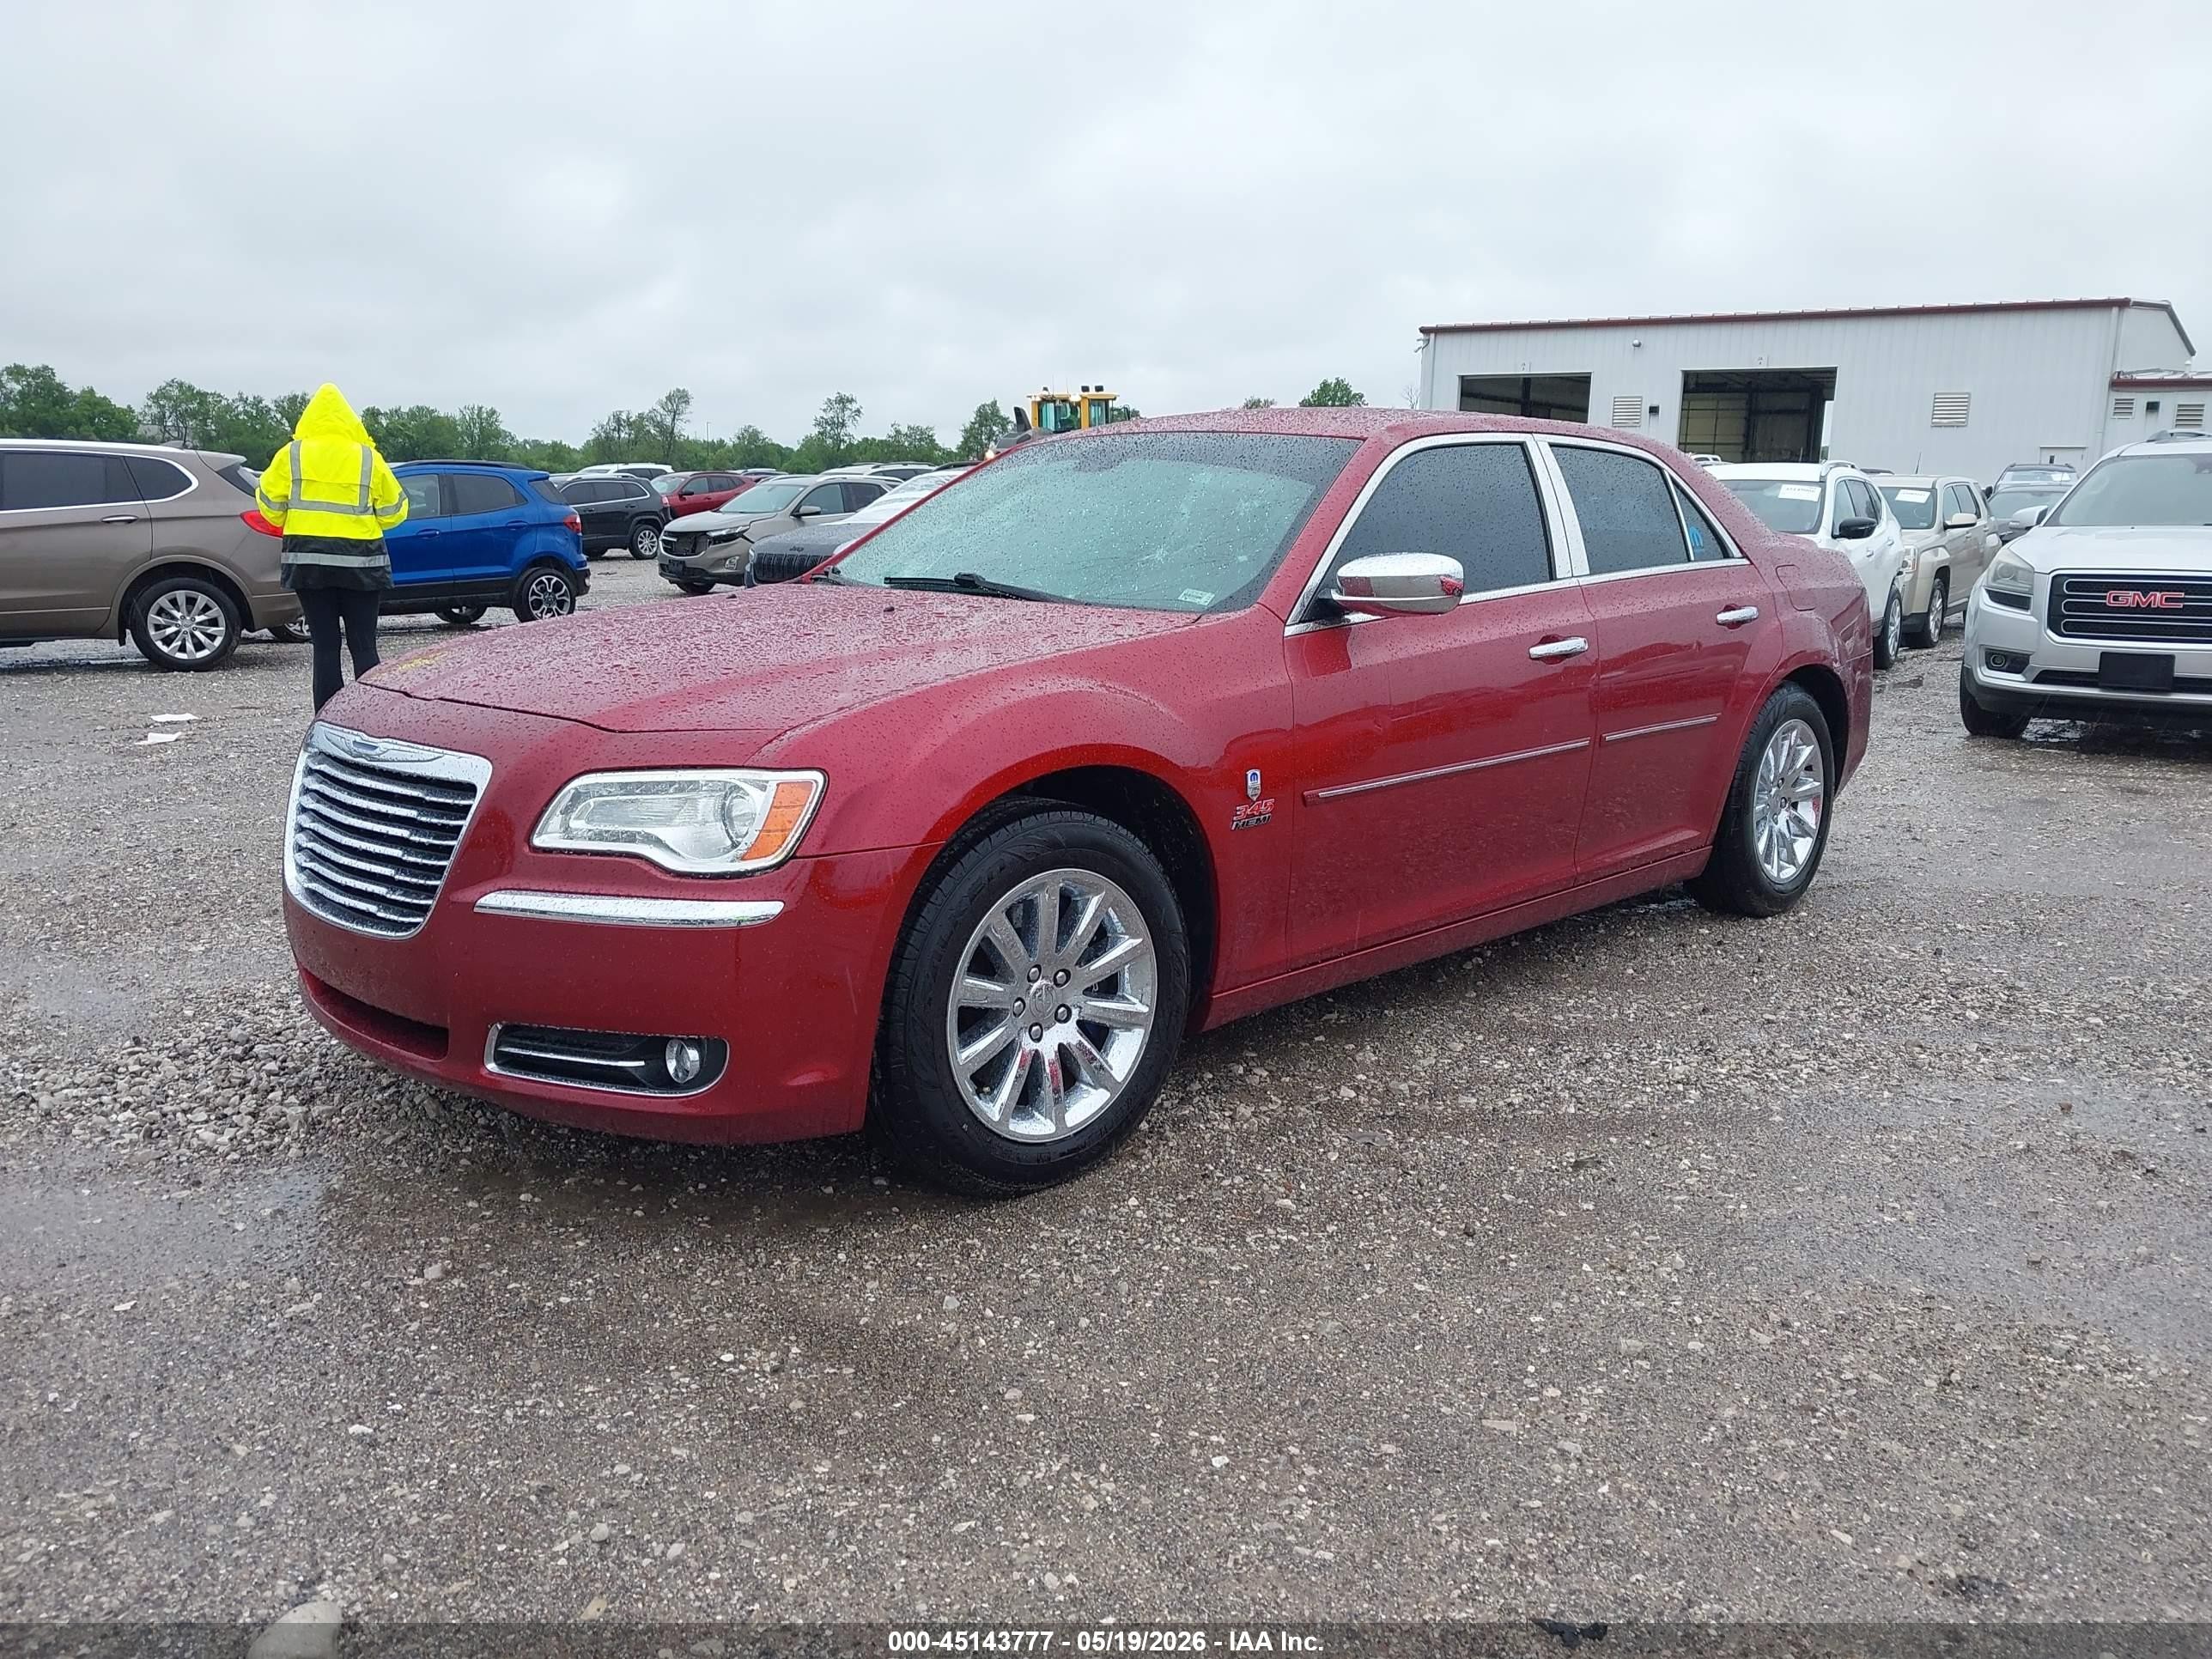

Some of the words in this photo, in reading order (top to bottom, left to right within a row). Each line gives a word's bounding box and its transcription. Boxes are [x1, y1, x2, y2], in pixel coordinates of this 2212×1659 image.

[2106, 590, 2185, 609] GMC
[1232, 798, 1275, 821] 345
[1231, 813, 1272, 831] HEMI
